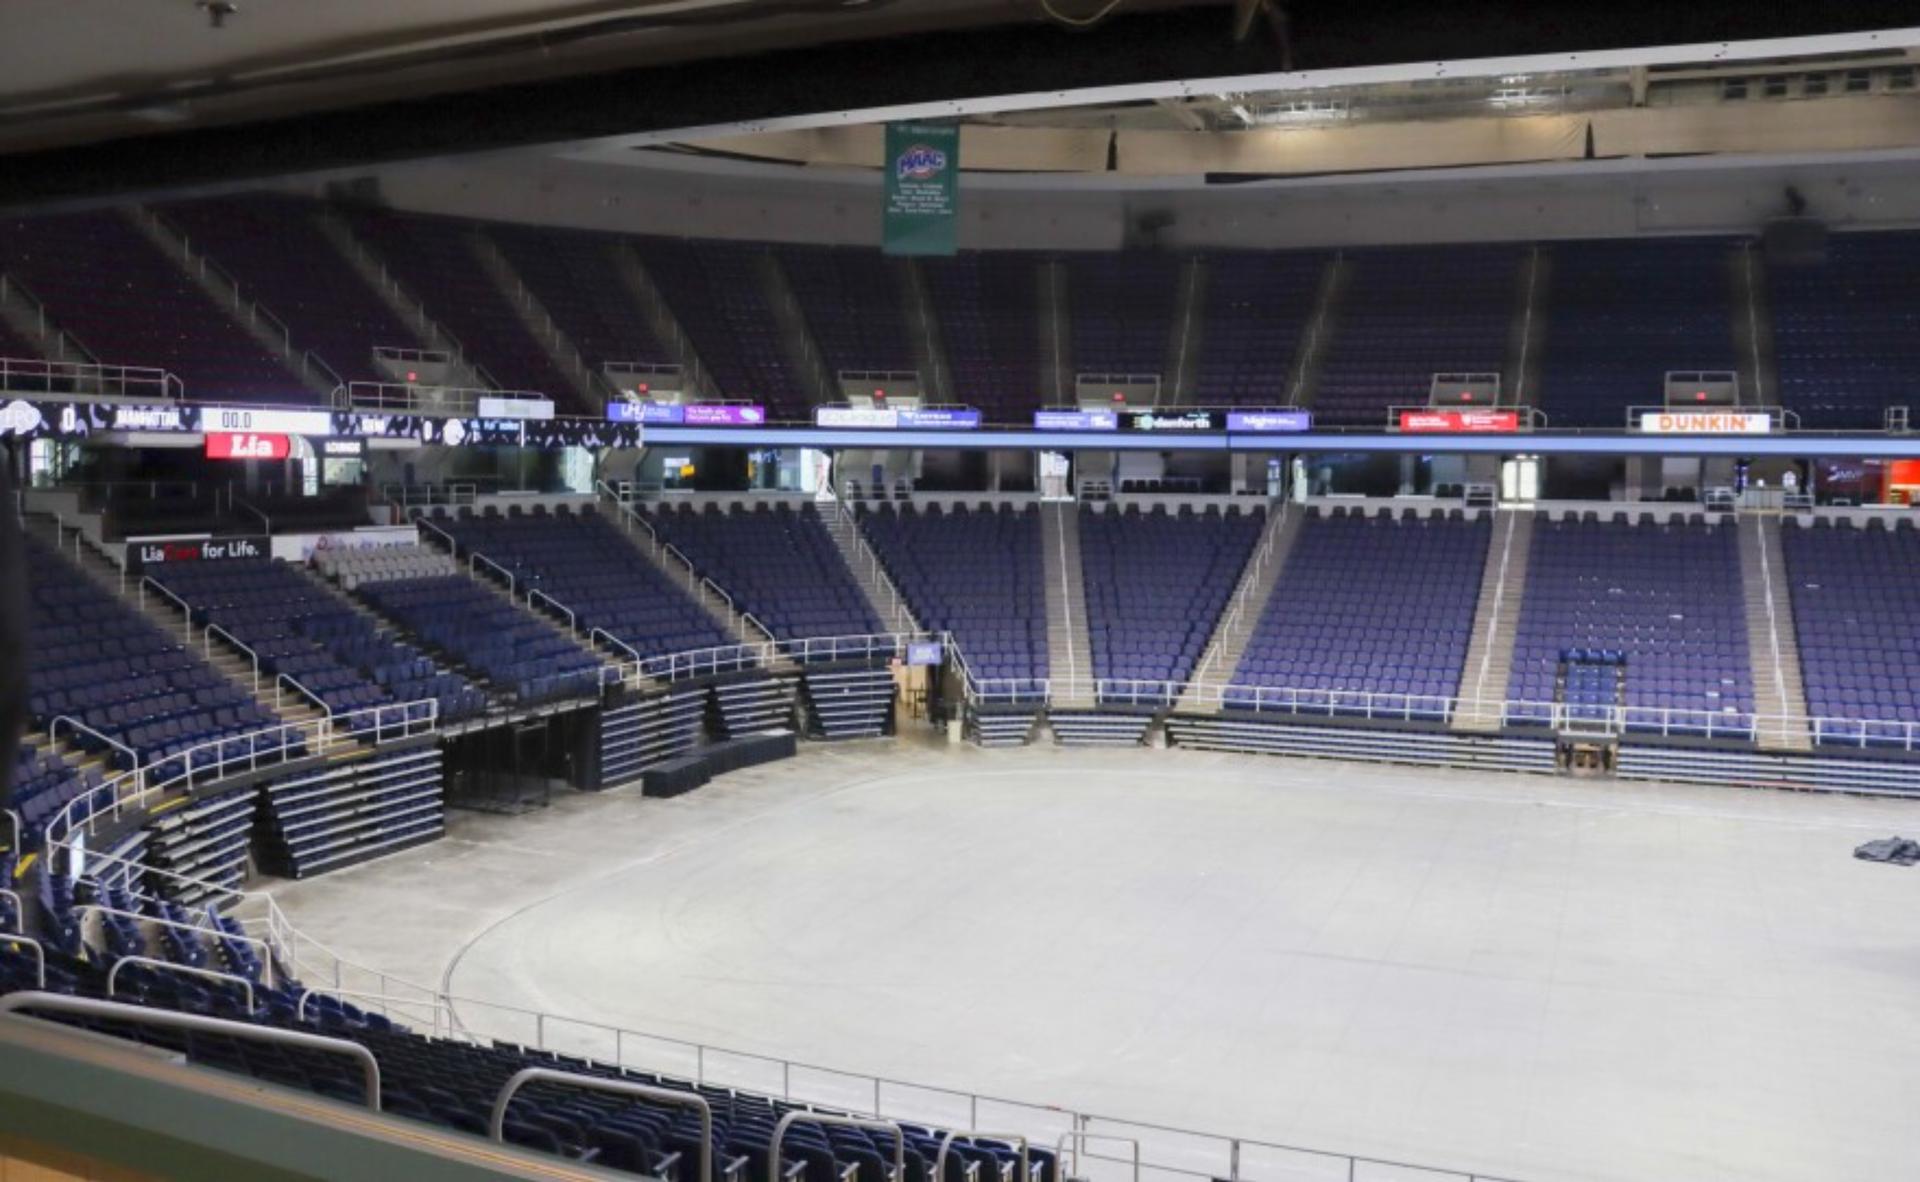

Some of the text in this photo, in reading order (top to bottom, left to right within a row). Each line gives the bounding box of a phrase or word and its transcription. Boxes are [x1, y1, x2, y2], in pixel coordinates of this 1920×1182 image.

[222, 411, 252, 428] 00.0
[230, 433, 274, 457] Lia
[202, 541, 225, 559] for
[228, 540, 259, 557] Life.
